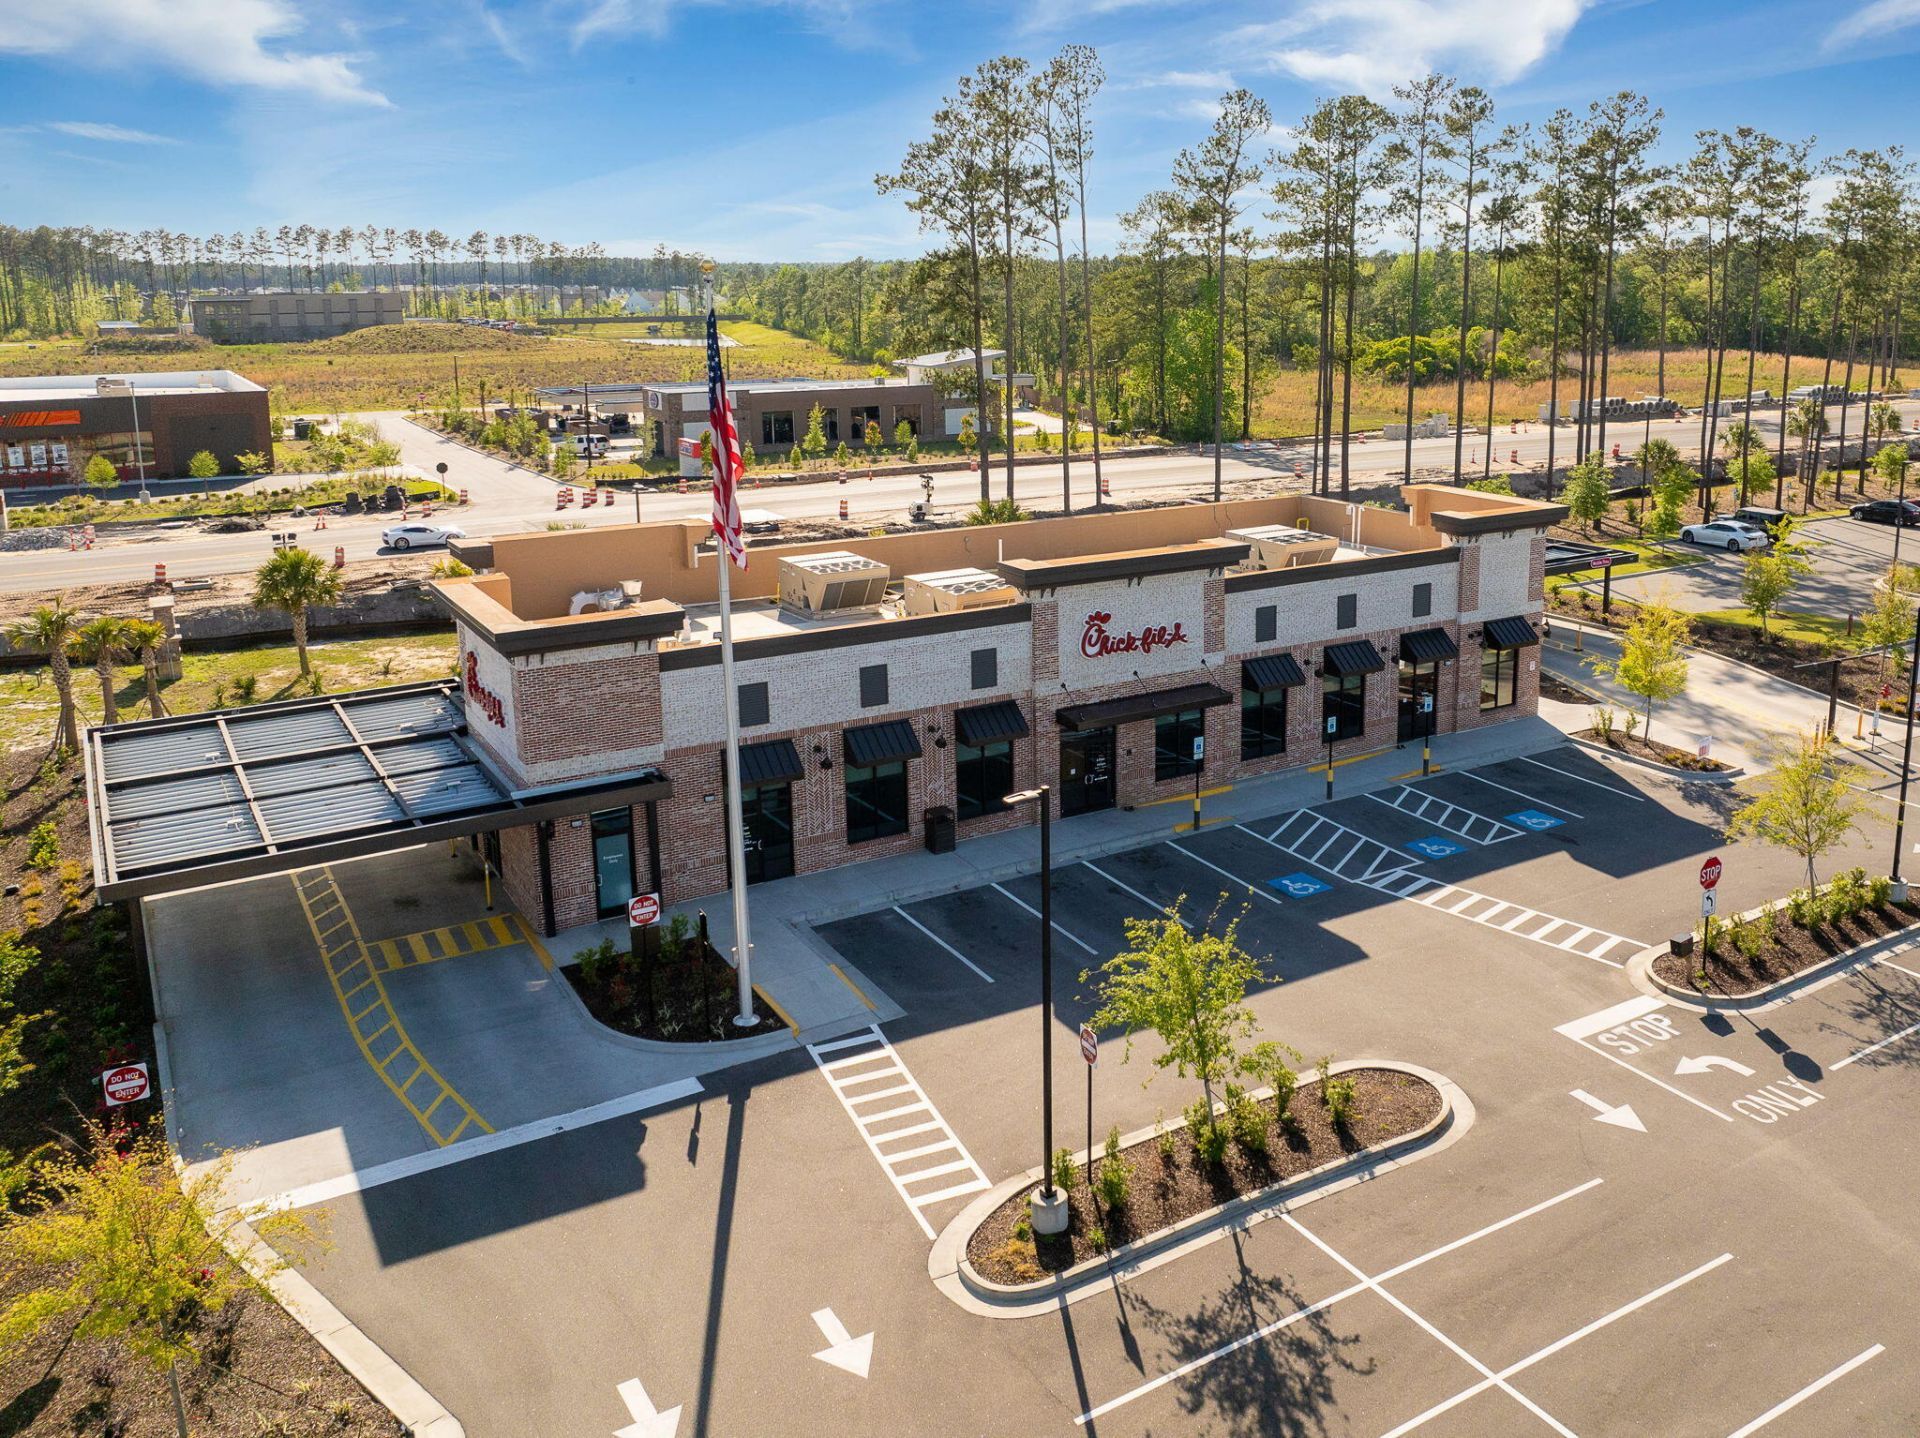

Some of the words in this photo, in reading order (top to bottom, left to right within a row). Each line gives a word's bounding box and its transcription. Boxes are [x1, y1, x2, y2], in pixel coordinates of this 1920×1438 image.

[1081, 610, 1188, 658] Chick-fil-A
[1701, 864, 1721, 882] STOP
[643, 899, 654, 907] NOT
[636, 912, 654, 921] ENTER
[1597, 1013, 1681, 1055] STOP
[111, 1075, 122, 1084] DO
[124, 1071, 140, 1081] NOT
[115, 1087, 140, 1098] ENTER
[1732, 1075, 1826, 1124] ONLY
